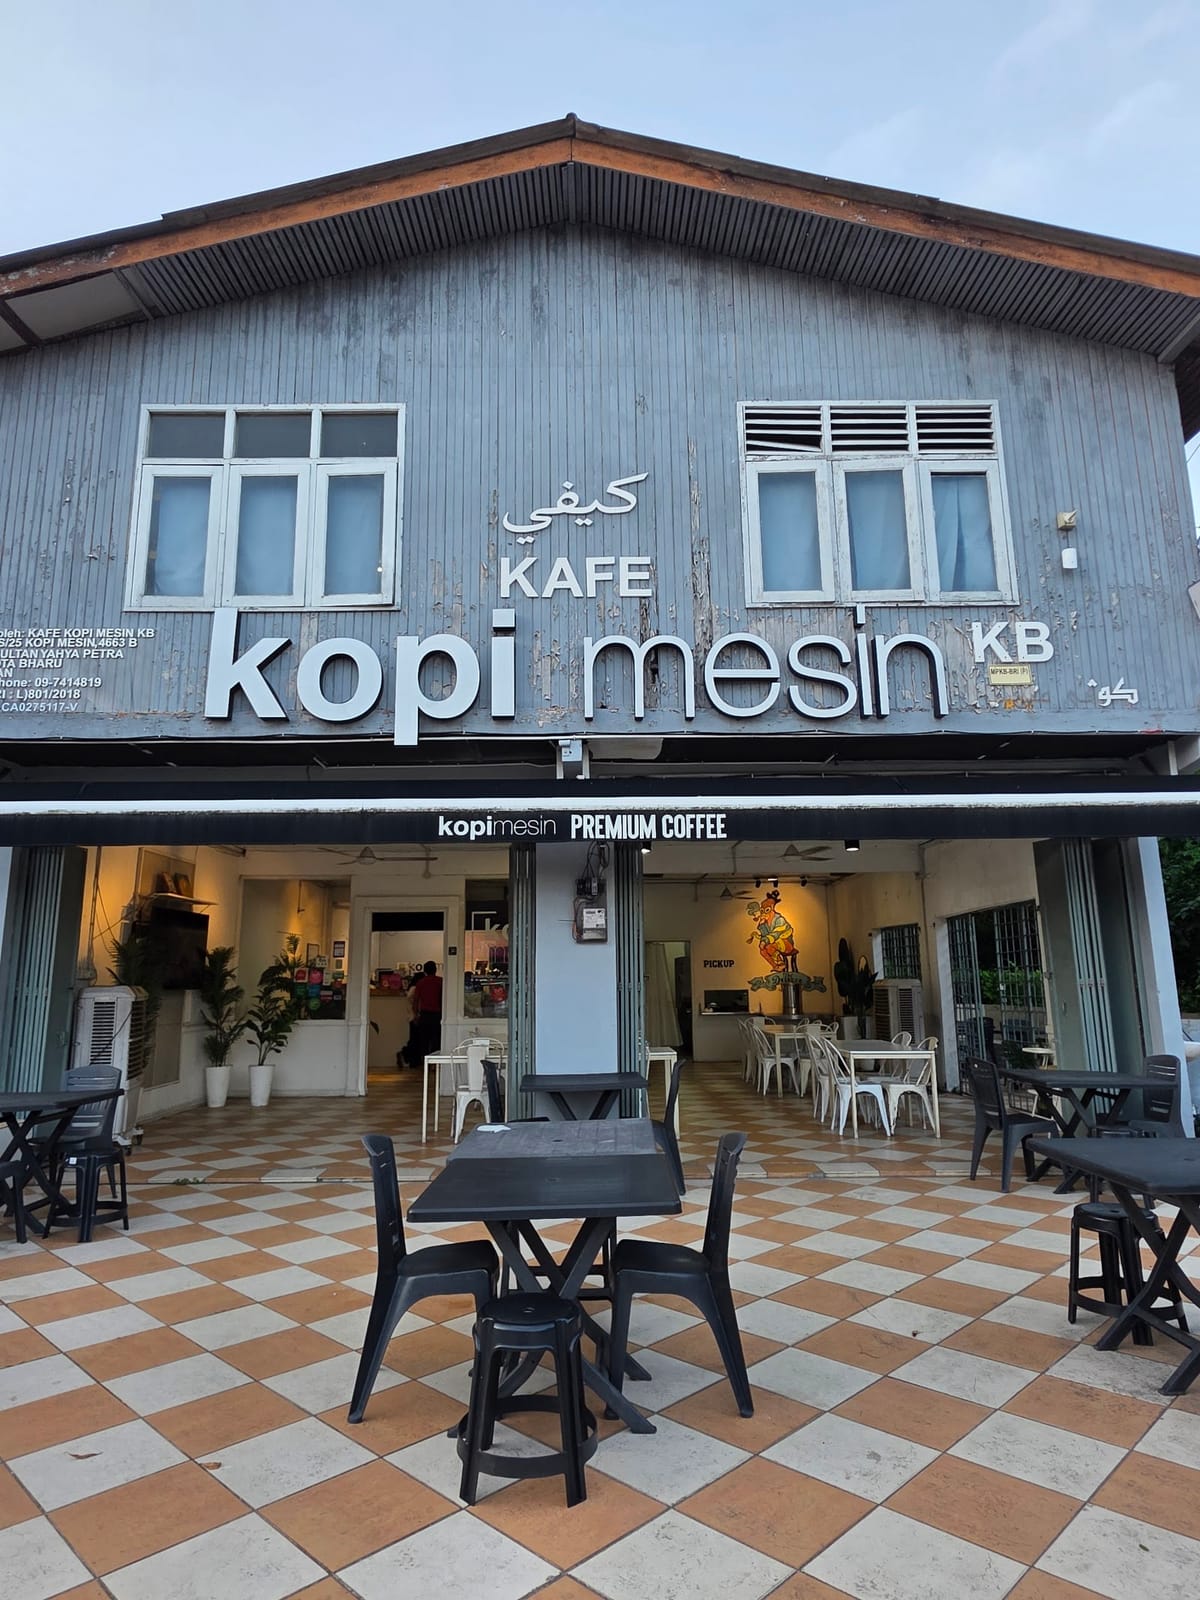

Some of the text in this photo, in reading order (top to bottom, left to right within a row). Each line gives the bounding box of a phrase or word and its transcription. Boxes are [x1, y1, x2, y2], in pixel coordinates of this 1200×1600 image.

[500, 556, 653, 598] KAFE
[28, 628, 61, 638] KAFE
[64, 628, 93, 638] KOPI
[96, 628, 134, 638] MESIN
[137, 628, 155, 638] KB
[25, 638, 55, 648] KOPI
[128, 638, 138, 648] B
[971, 621, 1054, 663] KB
[0, 649, 124, 659] ULTAN YAHYA PETRA
[0, 659, 63, 669] TA BHARU
[205, 604, 949, 746] kopi mesin
[0, 677, 102, 688] hone: 09-7414819
[0, 702, 78, 712] CA0275117-V
[570, 814, 656, 839] PREMIUM
[662, 813, 728, 839] COFFEE
[703, 959, 735, 969] PICKUP
